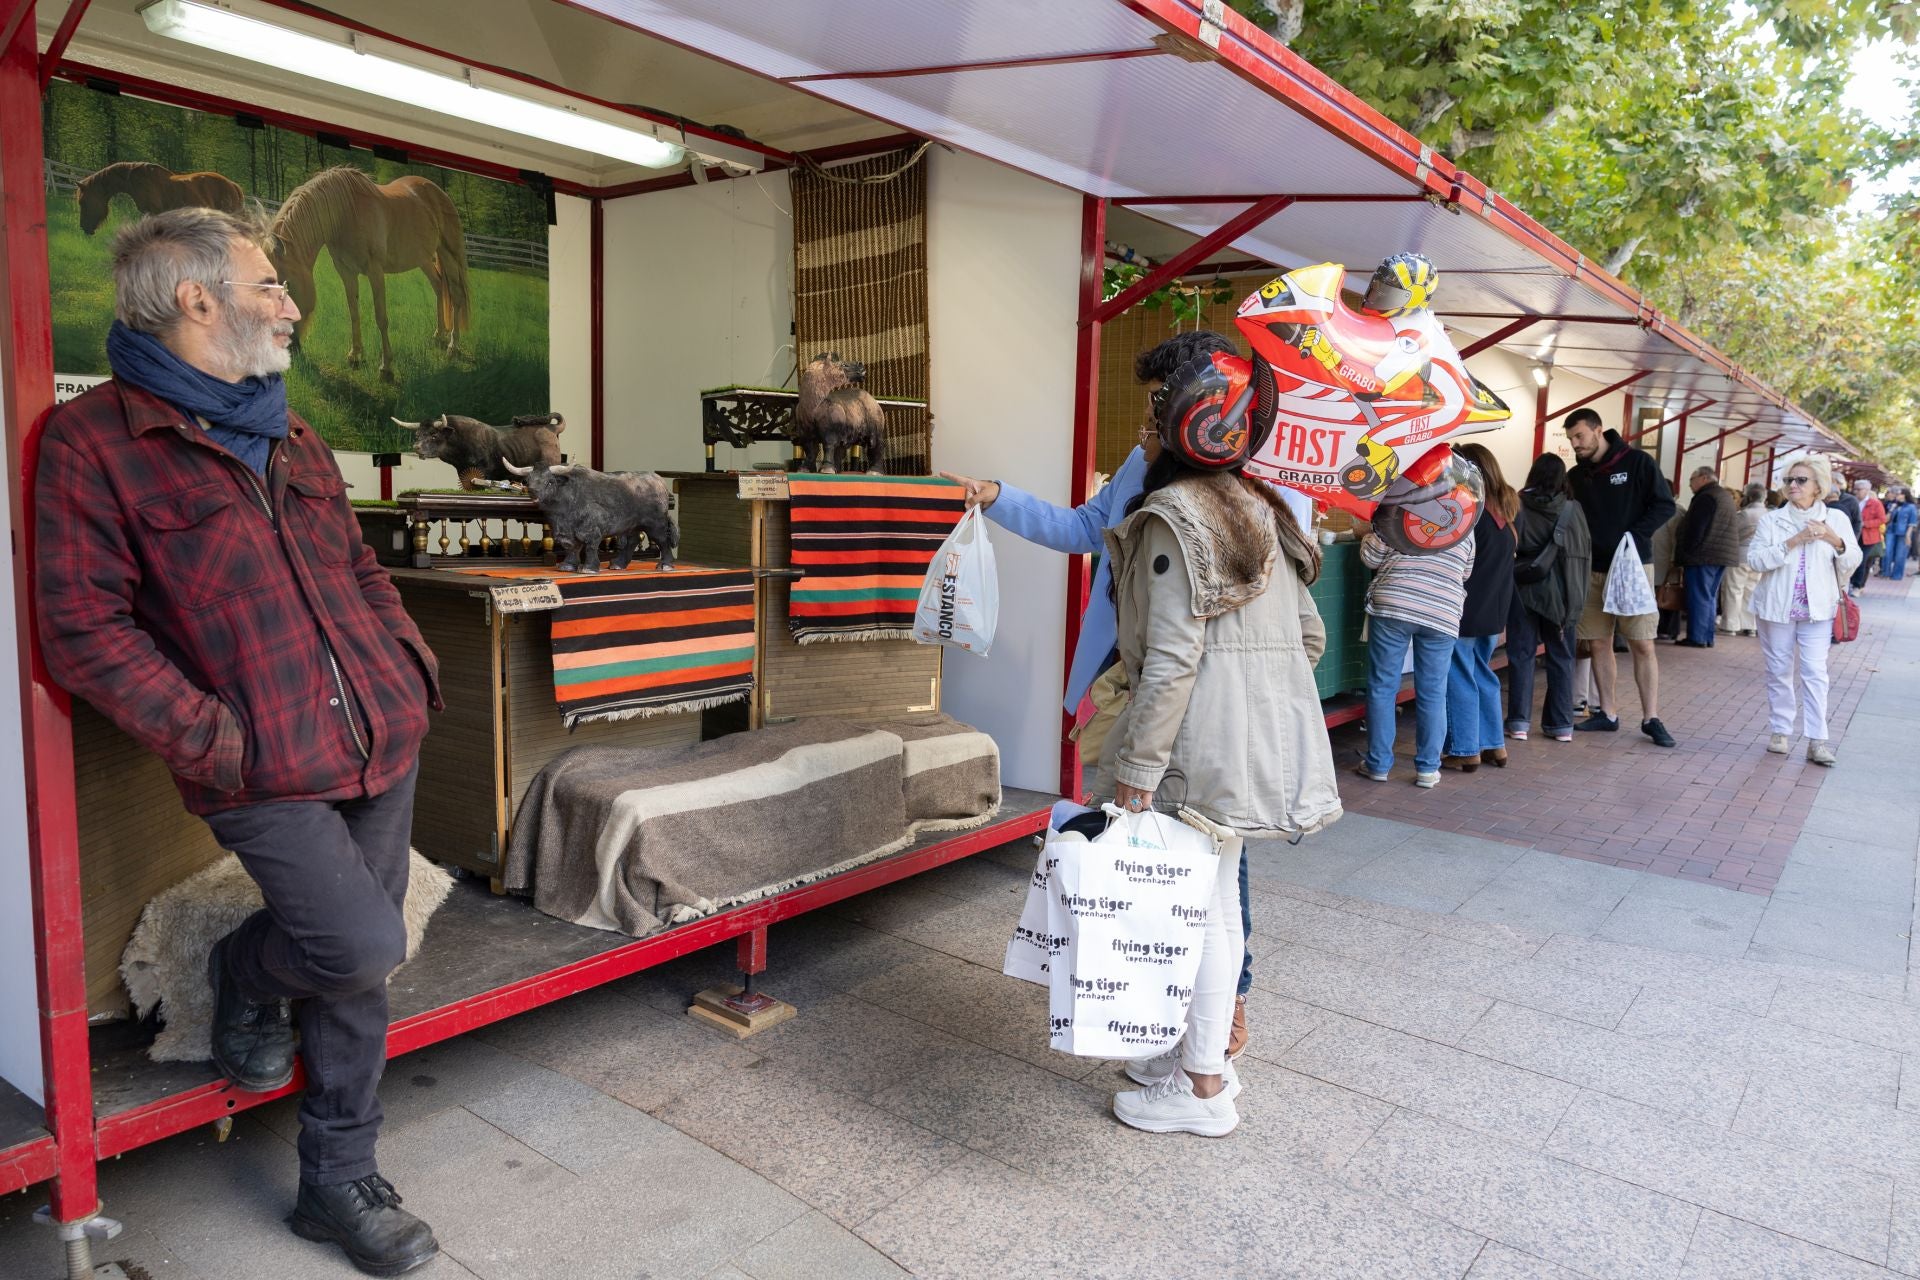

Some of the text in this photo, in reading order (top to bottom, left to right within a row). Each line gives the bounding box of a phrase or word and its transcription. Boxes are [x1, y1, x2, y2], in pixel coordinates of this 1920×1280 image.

[1339, 365, 1376, 392] GRABO
[1410, 416, 1431, 433] FAST
[1273, 421, 1346, 468] FAST
[1404, 430, 1432, 445] GRABO
[1279, 470, 1335, 485] GRABO
[939, 575, 957, 639] ESTANCO
[1114, 859, 1191, 878] flying tiger
[1128, 876, 1176, 885] copenhagen
[1099, 897, 1133, 912] tiger
[1112, 938, 1188, 957] flying tiger
[1125, 956, 1173, 965] copenhagen
[1096, 978, 1129, 993] tiger
[1166, 985, 1191, 1001] flyin
[1077, 993, 1115, 1001] penhagen
[1108, 1020, 1147, 1036] flying
[1122, 1037, 1168, 1046] copenhagen
